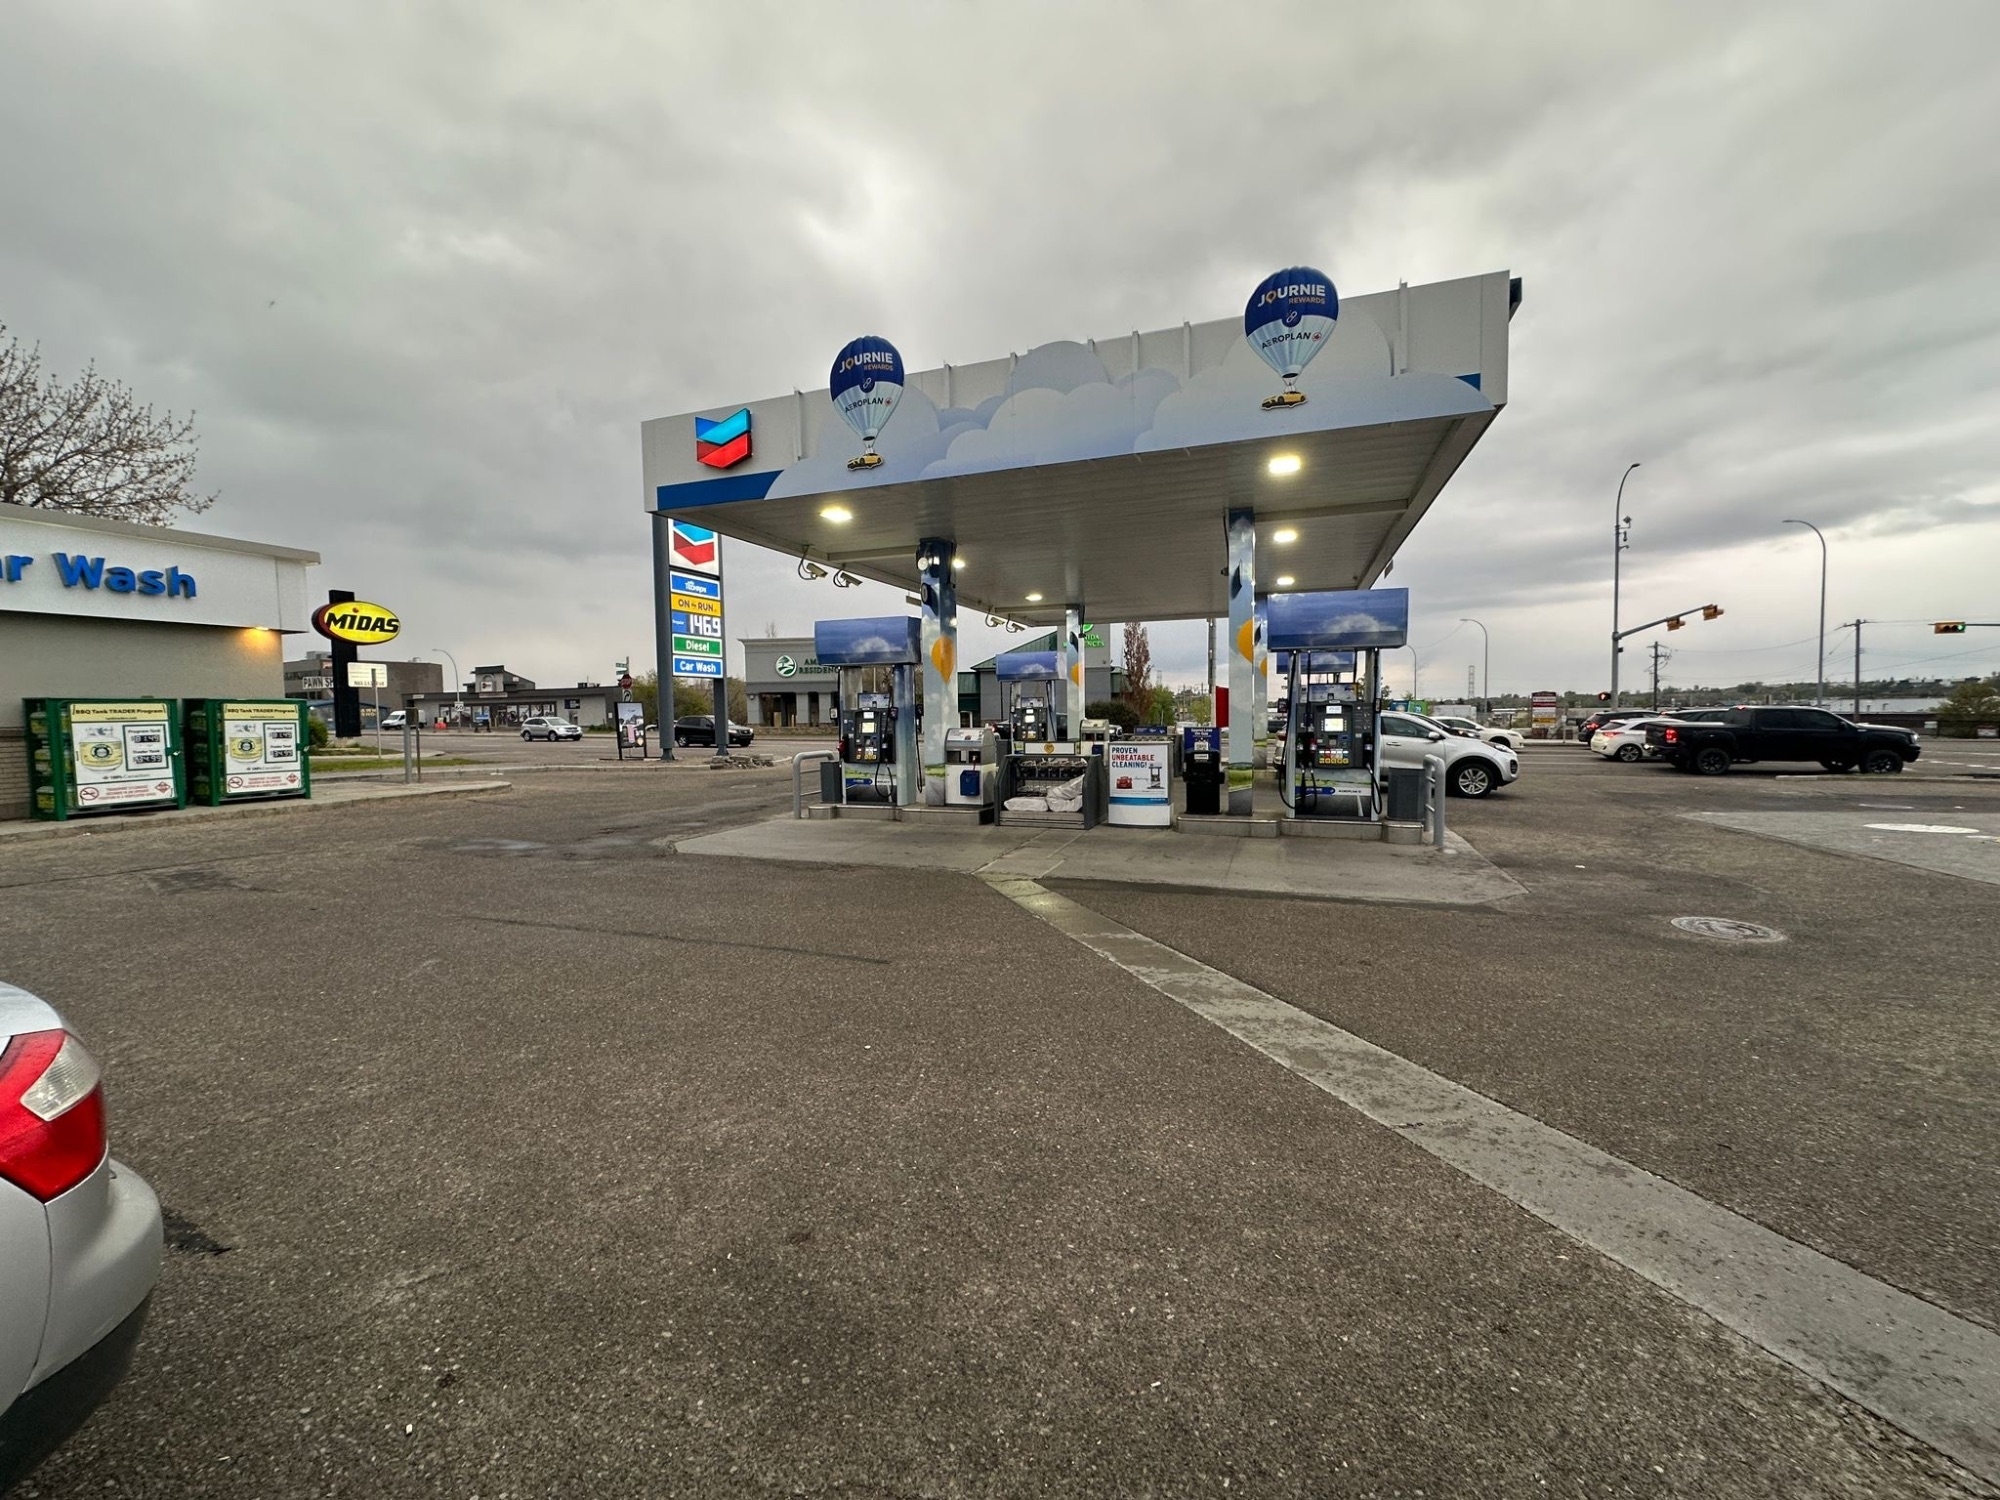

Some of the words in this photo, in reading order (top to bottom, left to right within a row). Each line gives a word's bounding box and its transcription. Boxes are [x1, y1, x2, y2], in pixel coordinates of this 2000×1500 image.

[1257, 284, 1326, 307] JOURNIE
[1288, 297, 1326, 305] REWARDS
[1261, 332, 1312, 349] AEROPLAN
[839, 351, 893, 374] JOURNIE
[844, 397, 884, 413] AEROPLAN
[52, 552, 196, 598] Wash
[678, 599, 690, 608] ON
[697, 602, 714, 612] RUN
[326, 612, 400, 633] MIDAS
[685, 640, 710, 652] Diesel
[679, 661, 694, 671] Car
[696, 662, 716, 673] Wash
[303, 678, 323, 688] PAWN
[324, 677, 333, 688] SH
